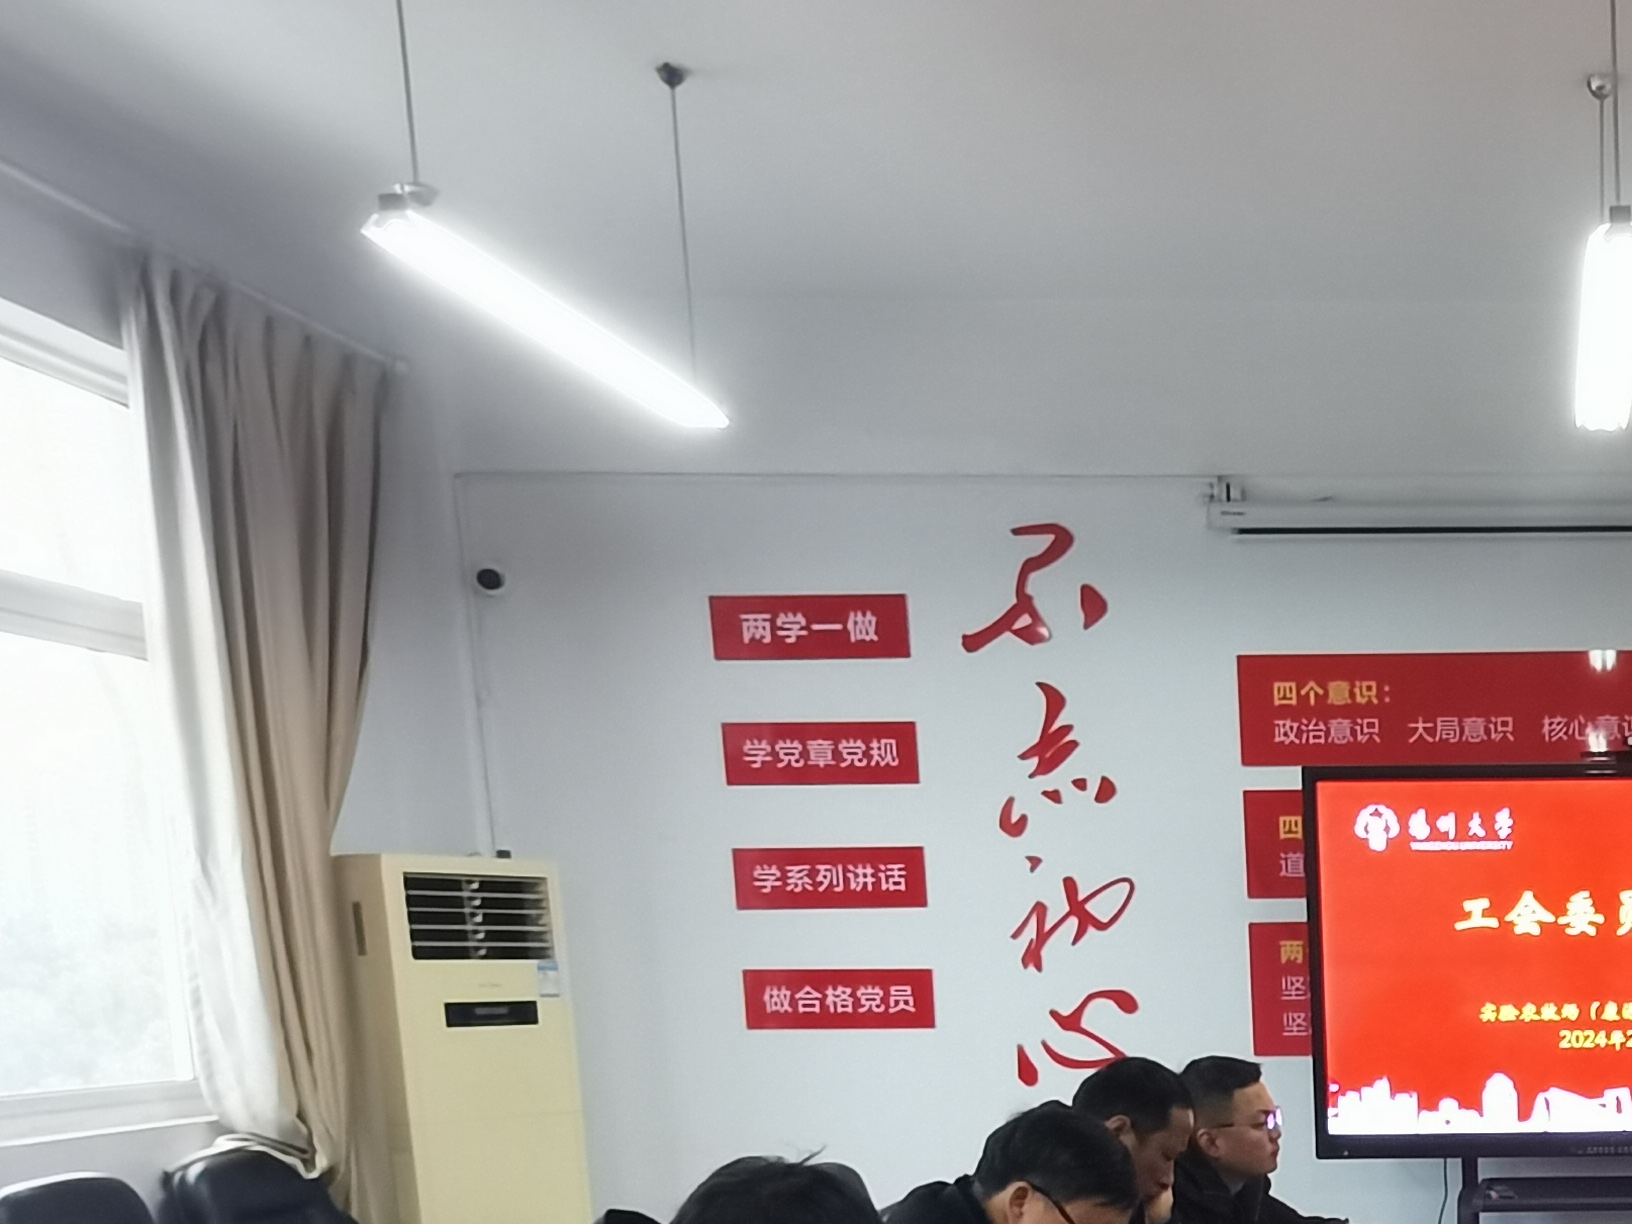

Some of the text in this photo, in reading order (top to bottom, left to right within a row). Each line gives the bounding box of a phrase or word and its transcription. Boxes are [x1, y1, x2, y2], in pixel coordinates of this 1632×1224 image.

[739, 610, 879, 644] 两学一做
[1273, 717, 1381, 745] 政治意识
[1407, 716, 1515, 744] 大局意识
[742, 738, 899, 769] 学党章党规
[1278, 815, 1303, 840] 四
[752, 863, 907, 893] 学系列讲话
[1279, 852, 1305, 877] 道
[1279, 940, 1304, 964] 两
[763, 985, 916, 1014] 做合格党员
[1280, 975, 1311, 1001] 坚
[1282, 1011, 1312, 1037] 坚
